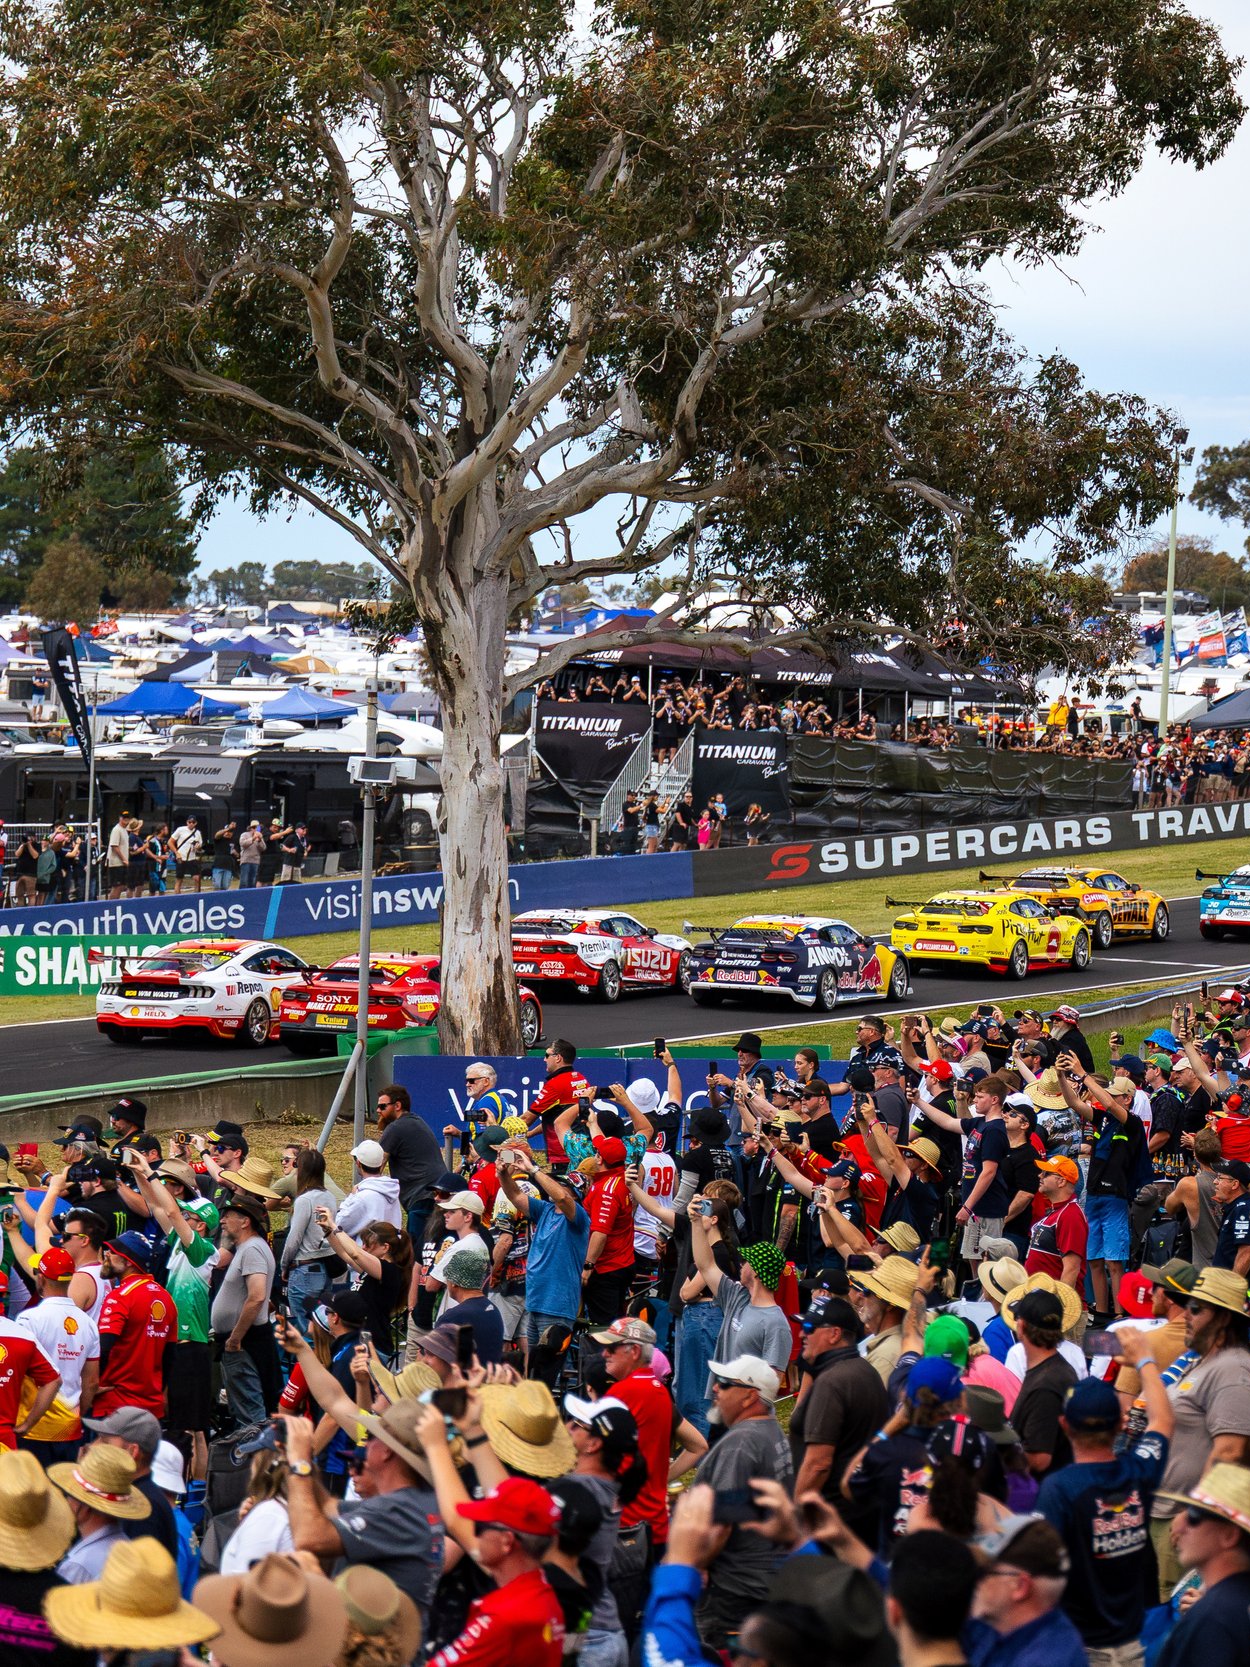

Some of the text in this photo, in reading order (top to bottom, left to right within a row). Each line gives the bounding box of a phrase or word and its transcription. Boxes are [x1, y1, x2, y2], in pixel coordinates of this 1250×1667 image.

[542, 716, 622, 732] TITANIUM
[699, 745, 776, 760] TITANIUM
[172, 767, 222, 776] ITANIUM
[819, 817, 1112, 873] SUPERCARS
[33, 899, 245, 936] south wales
[1001, 919, 1046, 946] Pizza Hut
[627, 948, 671, 971] ISUZU
[807, 946, 852, 968] AMPOL
[634, 968, 661, 981] TRUCKS
[716, 969, 757, 982] Red Bull
[152, 990, 179, 998] WASTE
[237, 981, 263, 995] Repco
[316, 994, 352, 1003] SONY
[306, 1002, 359, 1012] MAKE IT SUPER
[648, 1166, 674, 1197] 38
[1093, 1528, 1147, 1554] Holden
